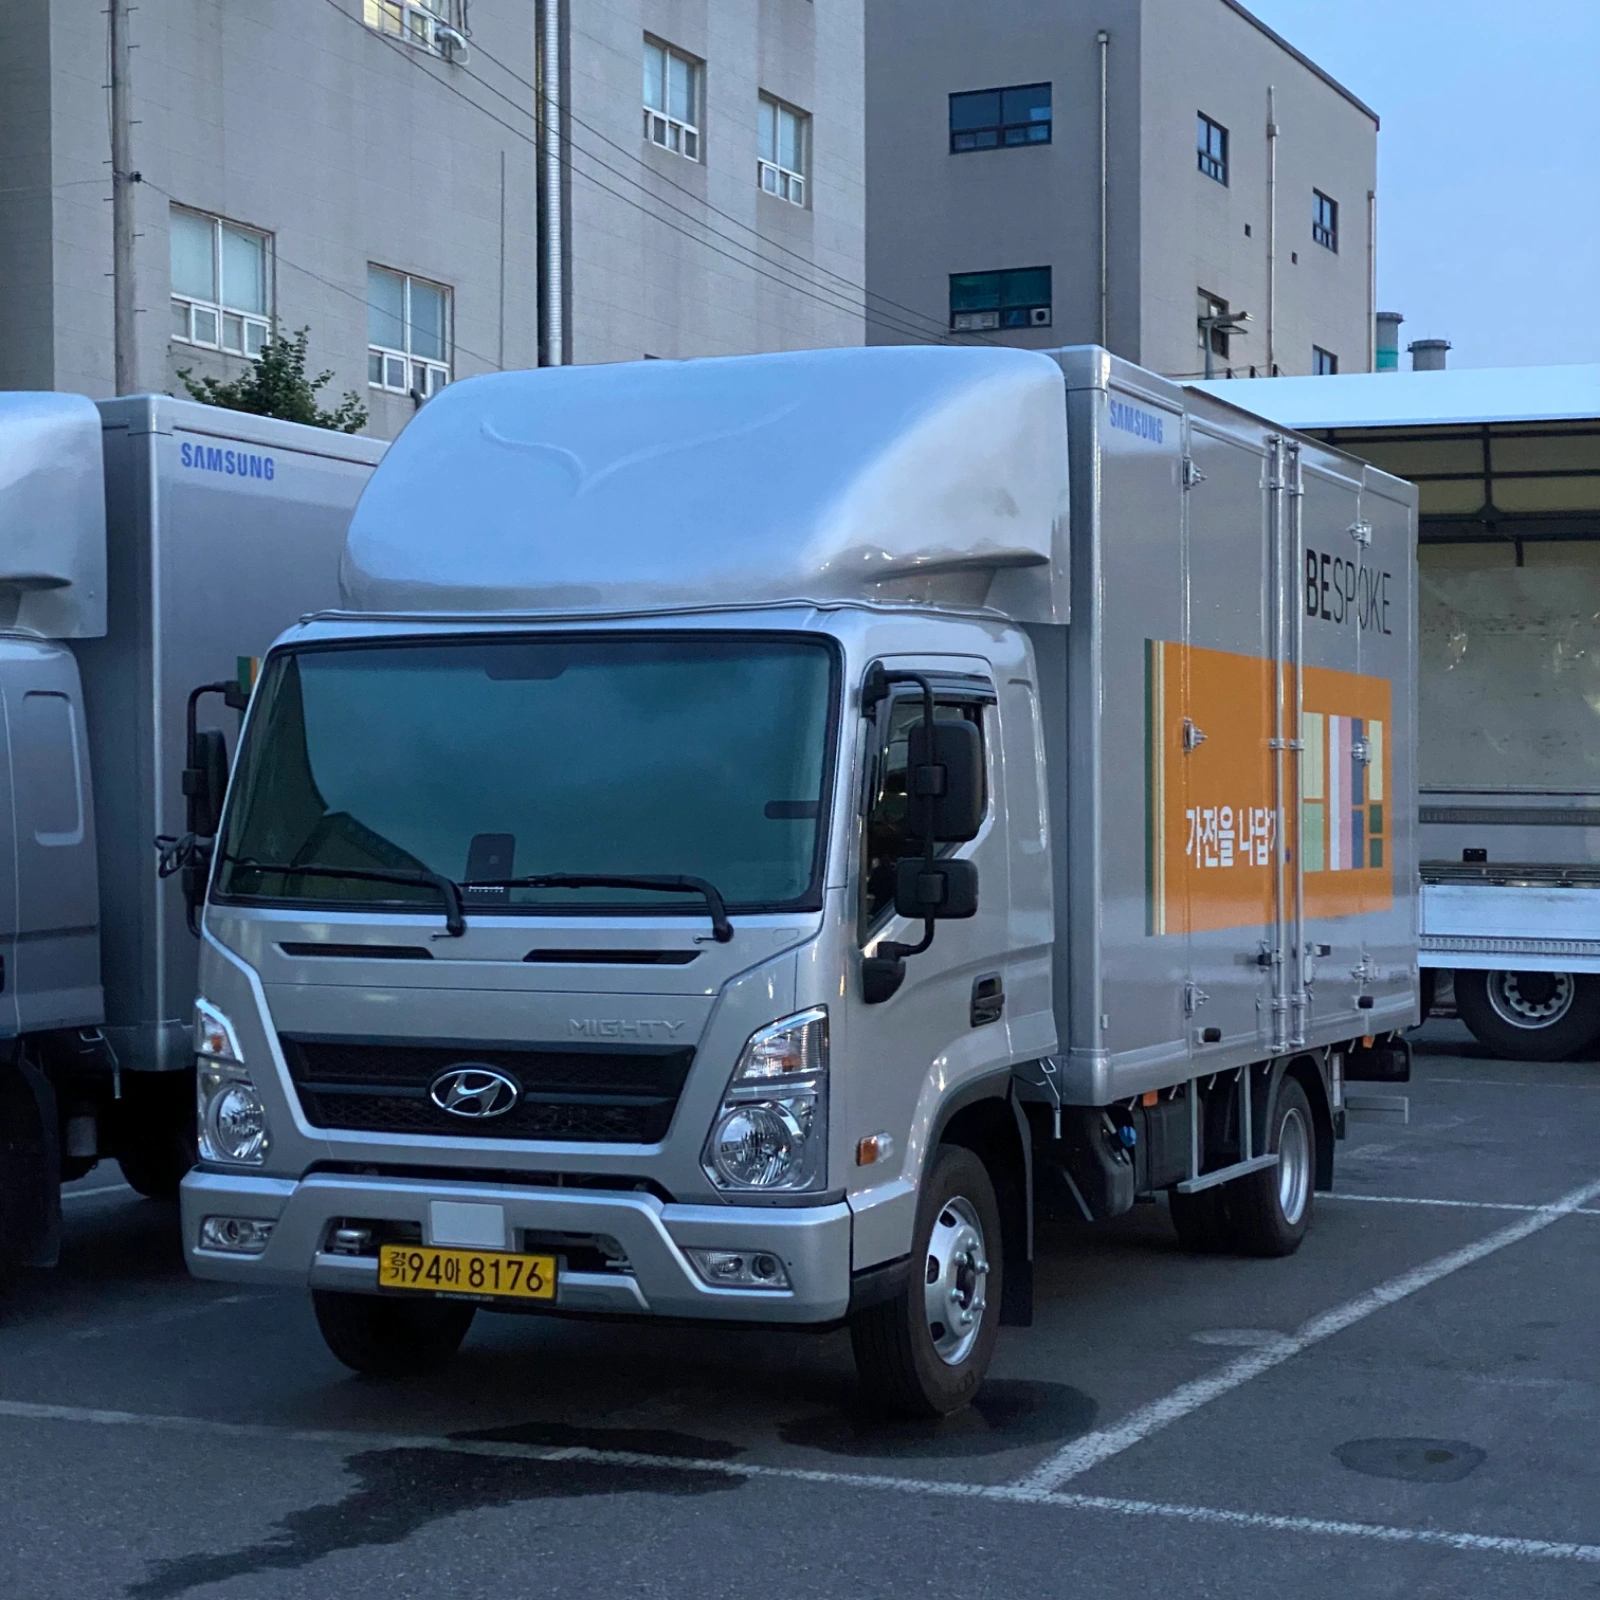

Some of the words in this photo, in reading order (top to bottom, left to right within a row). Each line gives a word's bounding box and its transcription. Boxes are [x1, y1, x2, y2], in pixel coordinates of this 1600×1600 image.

[1110, 399, 1163, 444] SAMSUNG
[181, 442, 275, 481] SAMSUNG
[1306, 548, 1392, 635] BESPOKE
[1186, 805, 1235, 869] 가전을
[567, 1019, 686, 1039] MIGHTY
[468, 1257, 544, 1293] 8176
